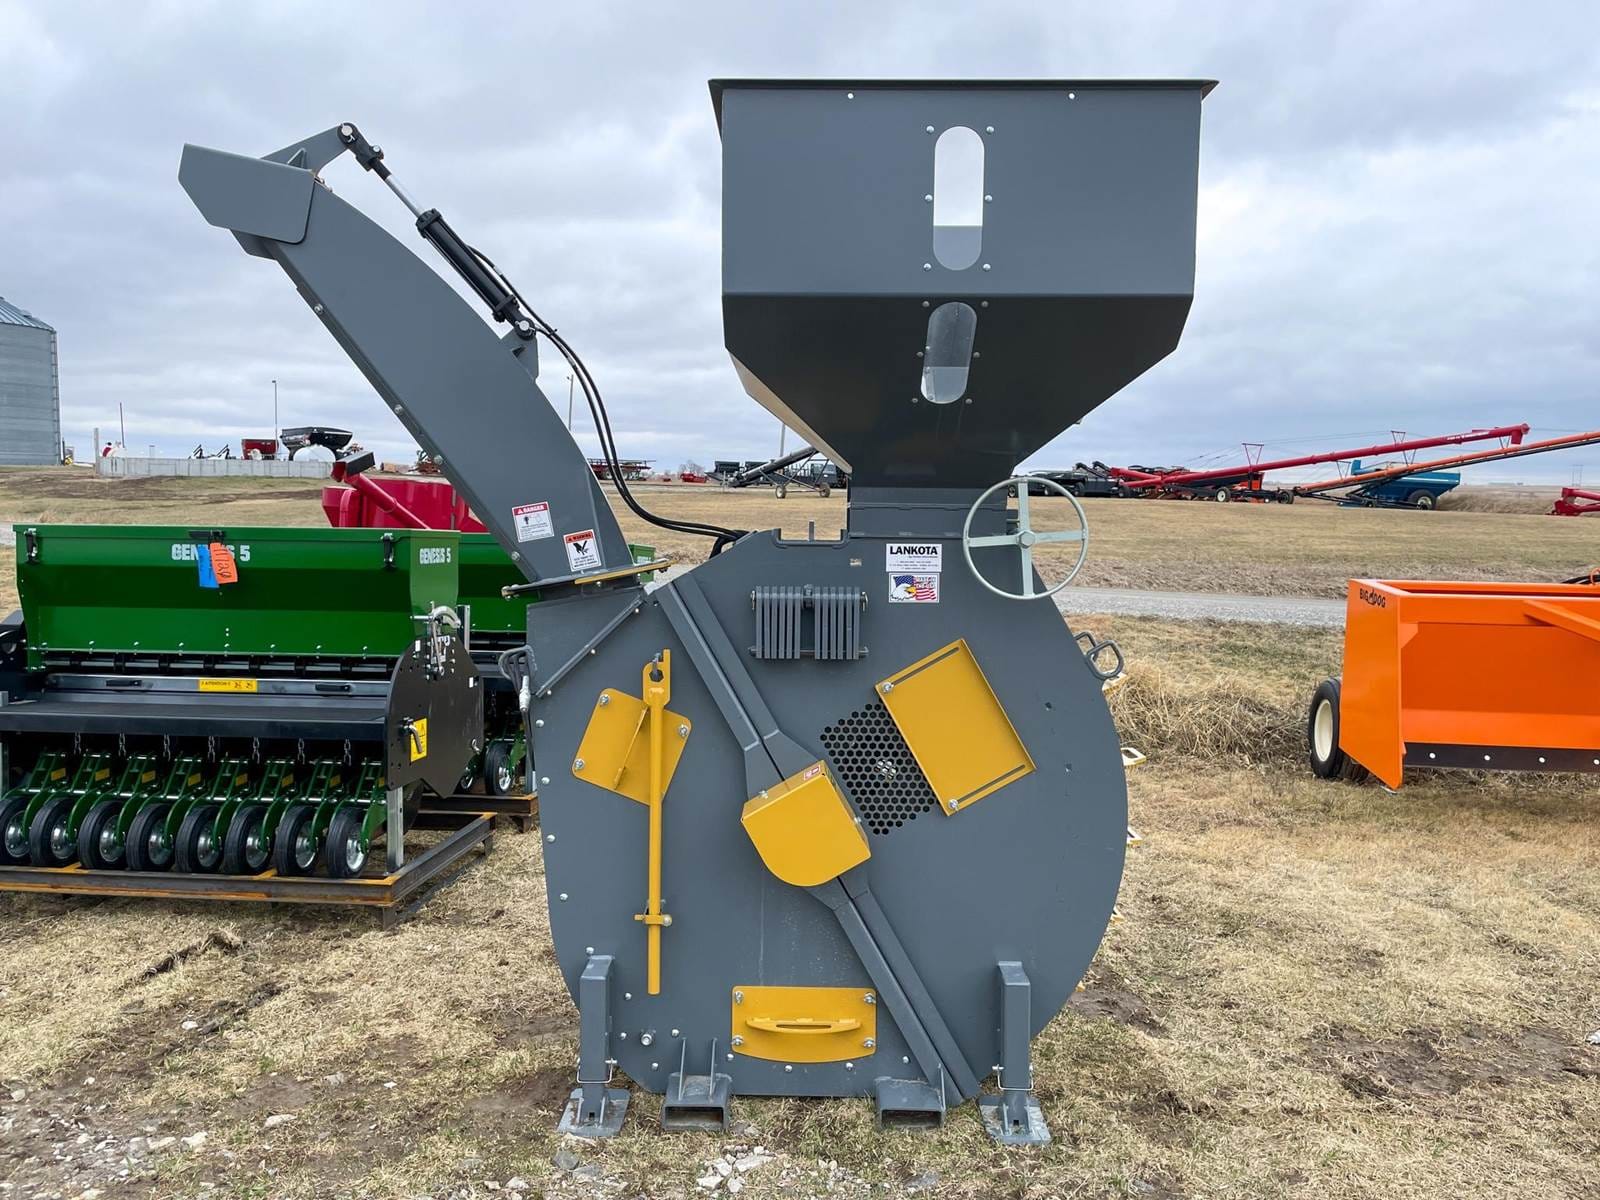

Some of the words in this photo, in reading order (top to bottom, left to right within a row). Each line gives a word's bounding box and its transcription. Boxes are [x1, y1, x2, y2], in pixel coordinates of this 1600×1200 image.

[239, 545, 251, 562] 5
[446, 547, 451, 563] 5
[889, 546, 938, 555] LANKOTA
[1359, 588, 1368, 601] BIG
[1374, 593, 1386, 608] DOG
